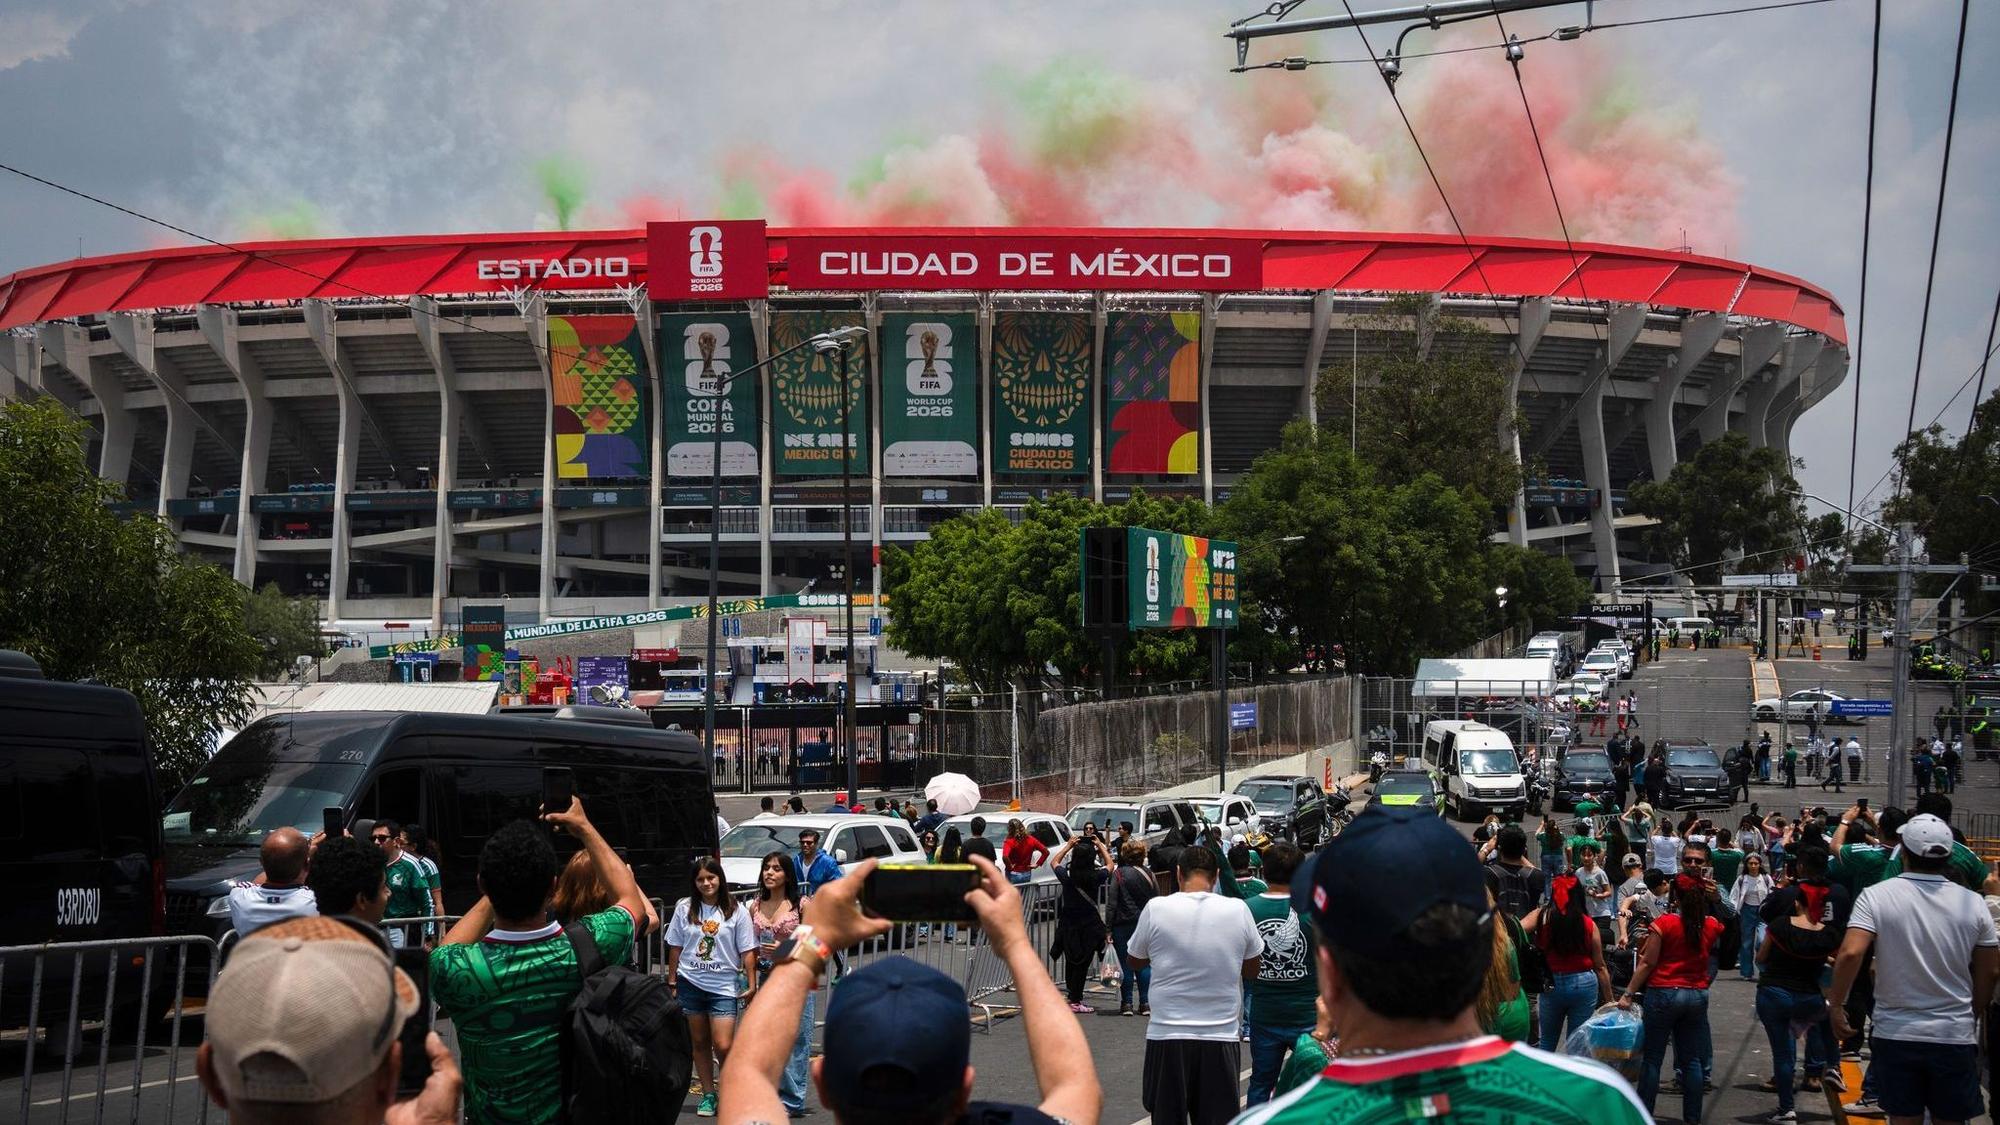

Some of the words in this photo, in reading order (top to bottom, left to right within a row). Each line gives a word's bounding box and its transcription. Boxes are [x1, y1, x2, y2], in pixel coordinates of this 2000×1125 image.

[819, 251, 979, 276] CIUDAD
[999, 252, 1055, 276] DE
[1070, 248, 1232, 277] MÉXICO
[478, 257, 629, 280] ESTADIO
[690, 284, 723, 292] 2026
[919, 381, 941, 389] FIFA
[687, 413, 734, 421] MUNDAL
[906, 406, 953, 417] 2026
[784, 433, 815, 447] WE
[817, 433, 857, 447] ARE
[1010, 432, 1074, 447] SOMOS
[784, 448, 829, 459] MEXICO
[831, 448, 857, 459] CIY
[1009, 448, 1057, 459] CIUDAD
[1058, 449, 1074, 459] DE
[1009, 457, 1074, 470] MÉXICO
[798, 594, 848, 606] SOMOS
[1592, 605, 1633, 613] PUERTA
[514, 624, 565, 639] MUNDIAL
[566, 622, 582, 632] DE
[583, 620, 599, 630] LA
[599, 616, 625, 628] FIFA
[626, 611, 667, 625] 2026
[631, 653, 640, 661] 30
[340, 750, 364, 761] 270
[57, 888, 101, 927] 93RD8U
[1259, 968, 1305, 979] MÉXICO
